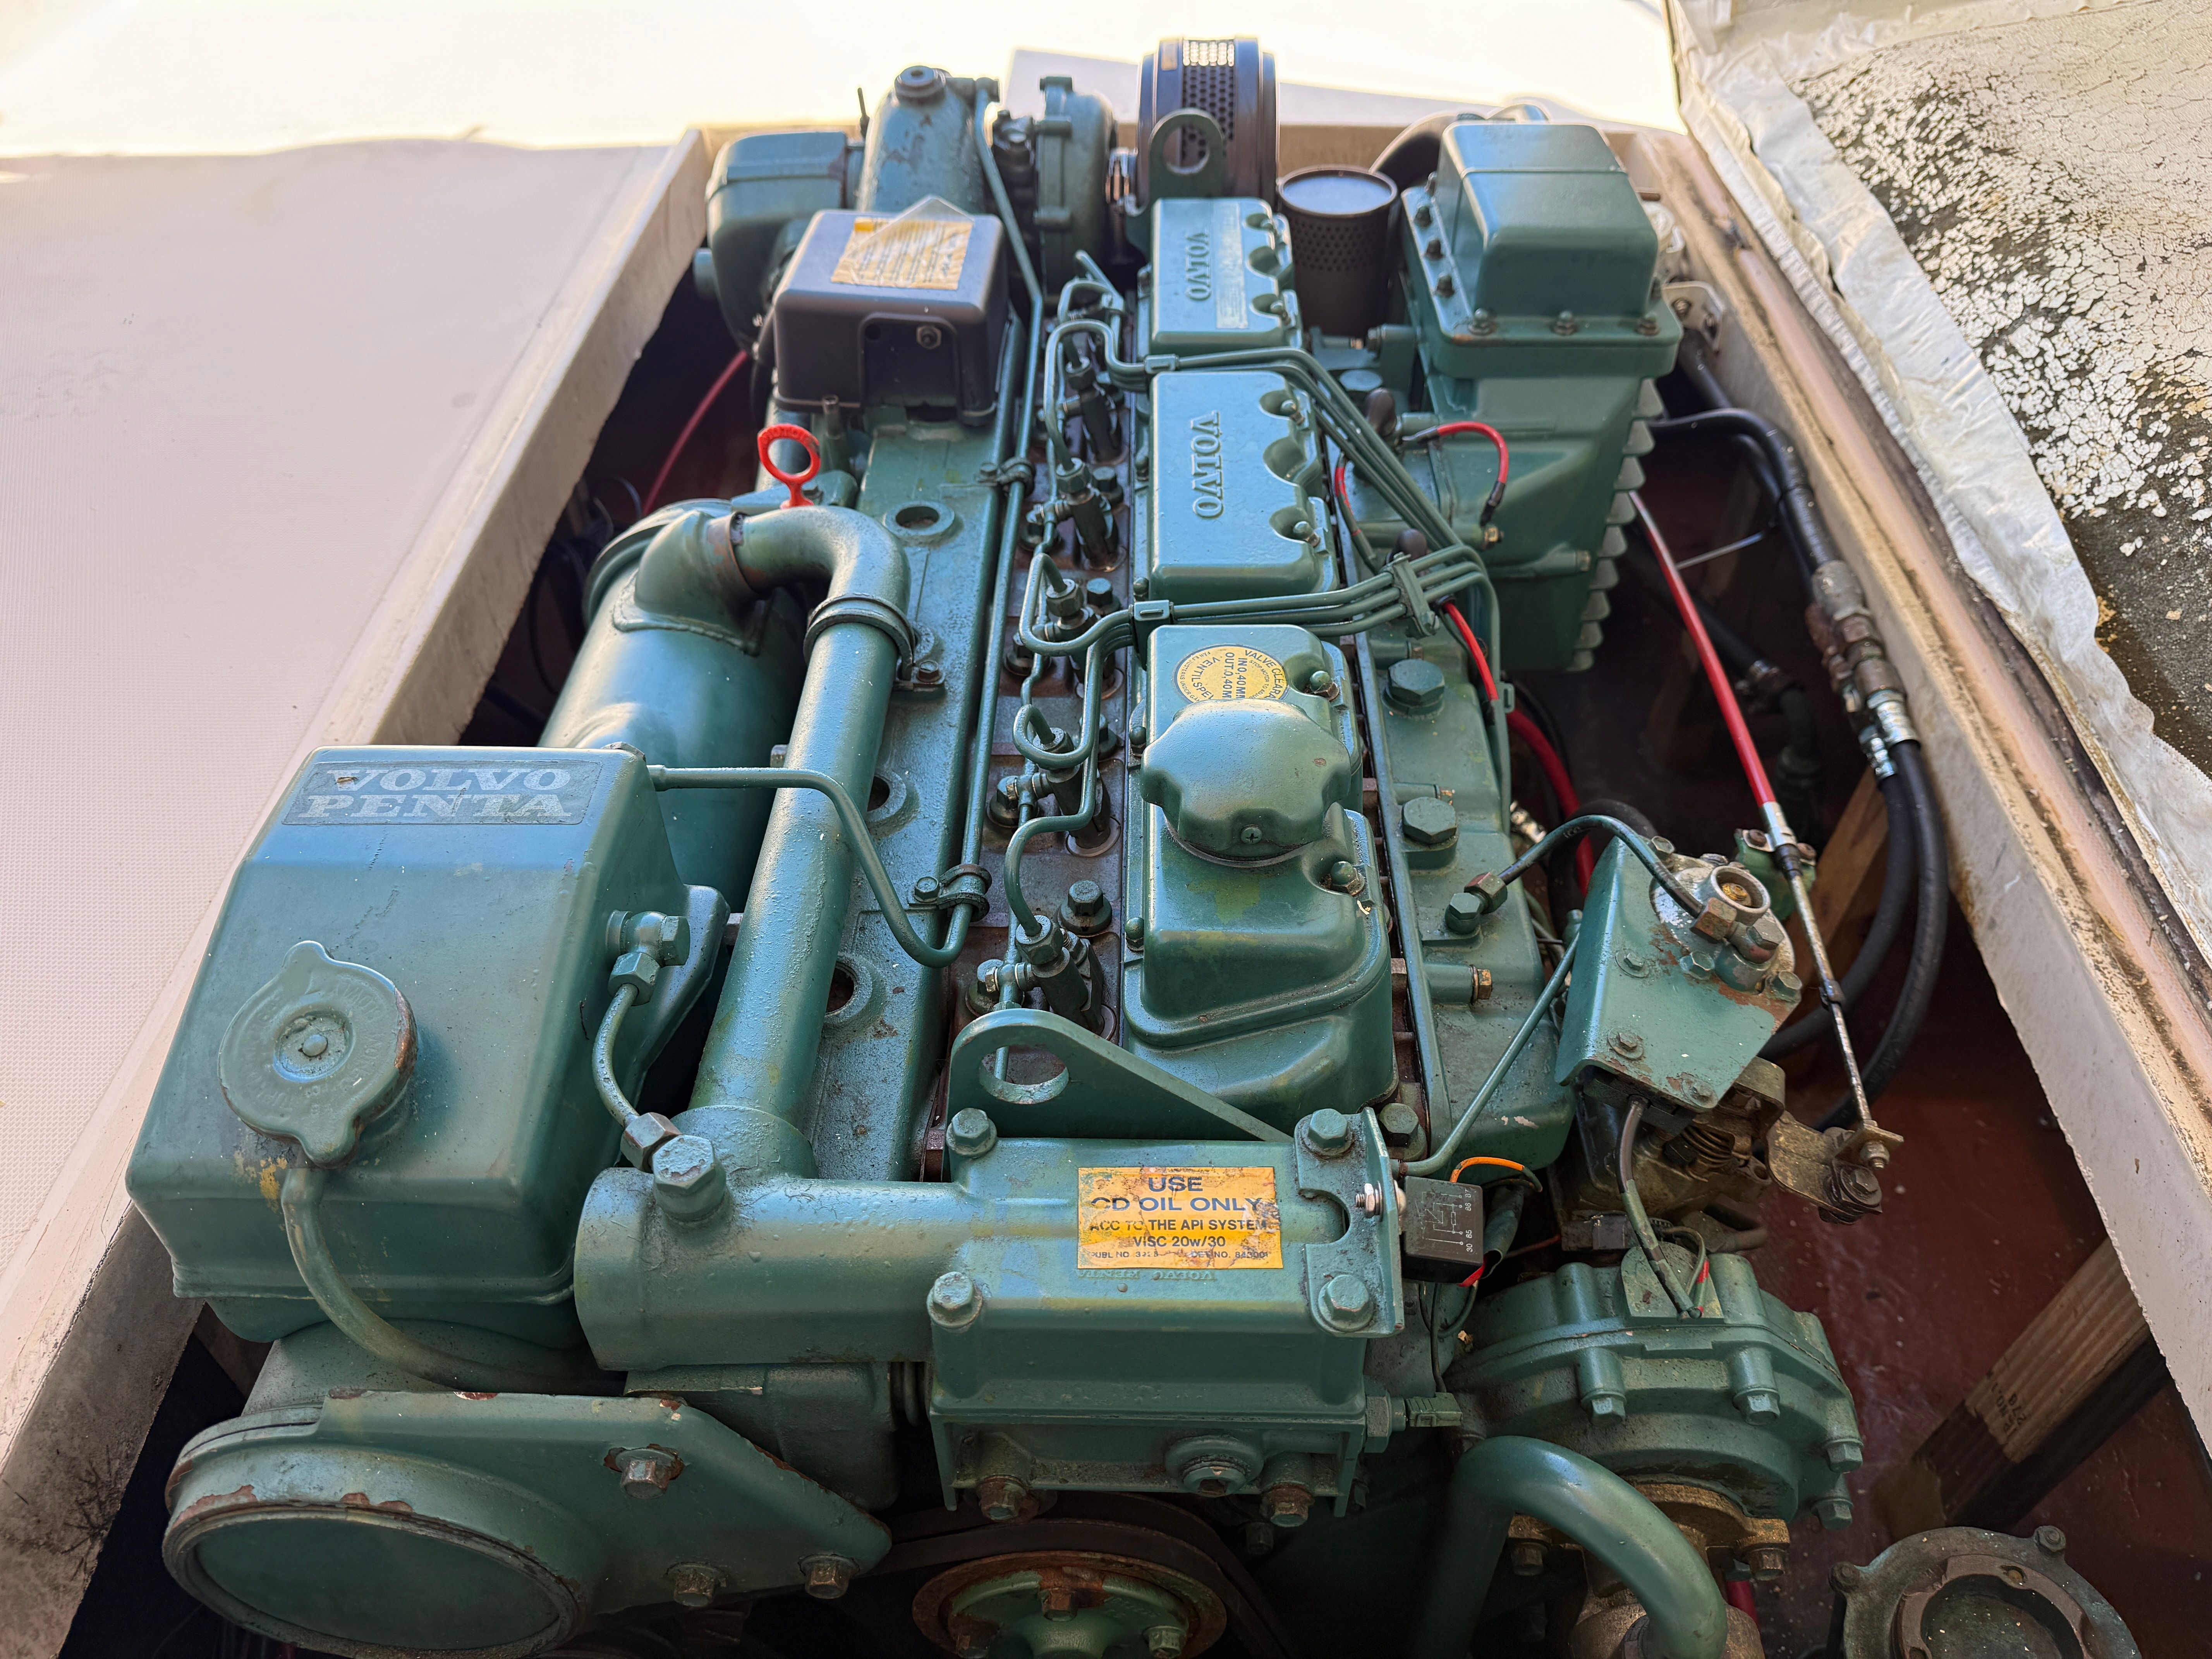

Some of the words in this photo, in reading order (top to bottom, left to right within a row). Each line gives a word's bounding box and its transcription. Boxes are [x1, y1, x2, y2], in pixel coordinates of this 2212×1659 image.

[1185, 229, 1212, 301] VOLVO
[1190, 410, 1224, 520] VOLVO
[1238, 658, 1247, 666] IN
[1245, 650, 1276, 668] VALVE
[1235, 667, 1247, 685] 0,40
[1249, 660, 1262, 670] STOP
[1261, 668, 1270, 682] MOTOR
[326, 768, 571, 791] VOLVO
[298, 794, 572, 818] PENTA
[1149, 1176, 1203, 1192] USE
[1091, 1197, 1130, 1211] CD
[1139, 1197, 1182, 1211] OIL
[1190, 1197, 1262, 1211] ONLY
[1465, 1202, 1471, 1211] 86
[1125, 1220, 1145, 1231] TO
[1148, 1219, 1176, 1231] THE
[1181, 1219, 1203, 1230] API
[1209, 1219, 1266, 1231] SYSTEM
[1133, 1236, 1167, 1247] VISC
[1172, 1235, 1226, 1247] 20w/30
[1465, 1230, 1472, 1238] 85
[1466, 1243, 1473, 1252] 30
